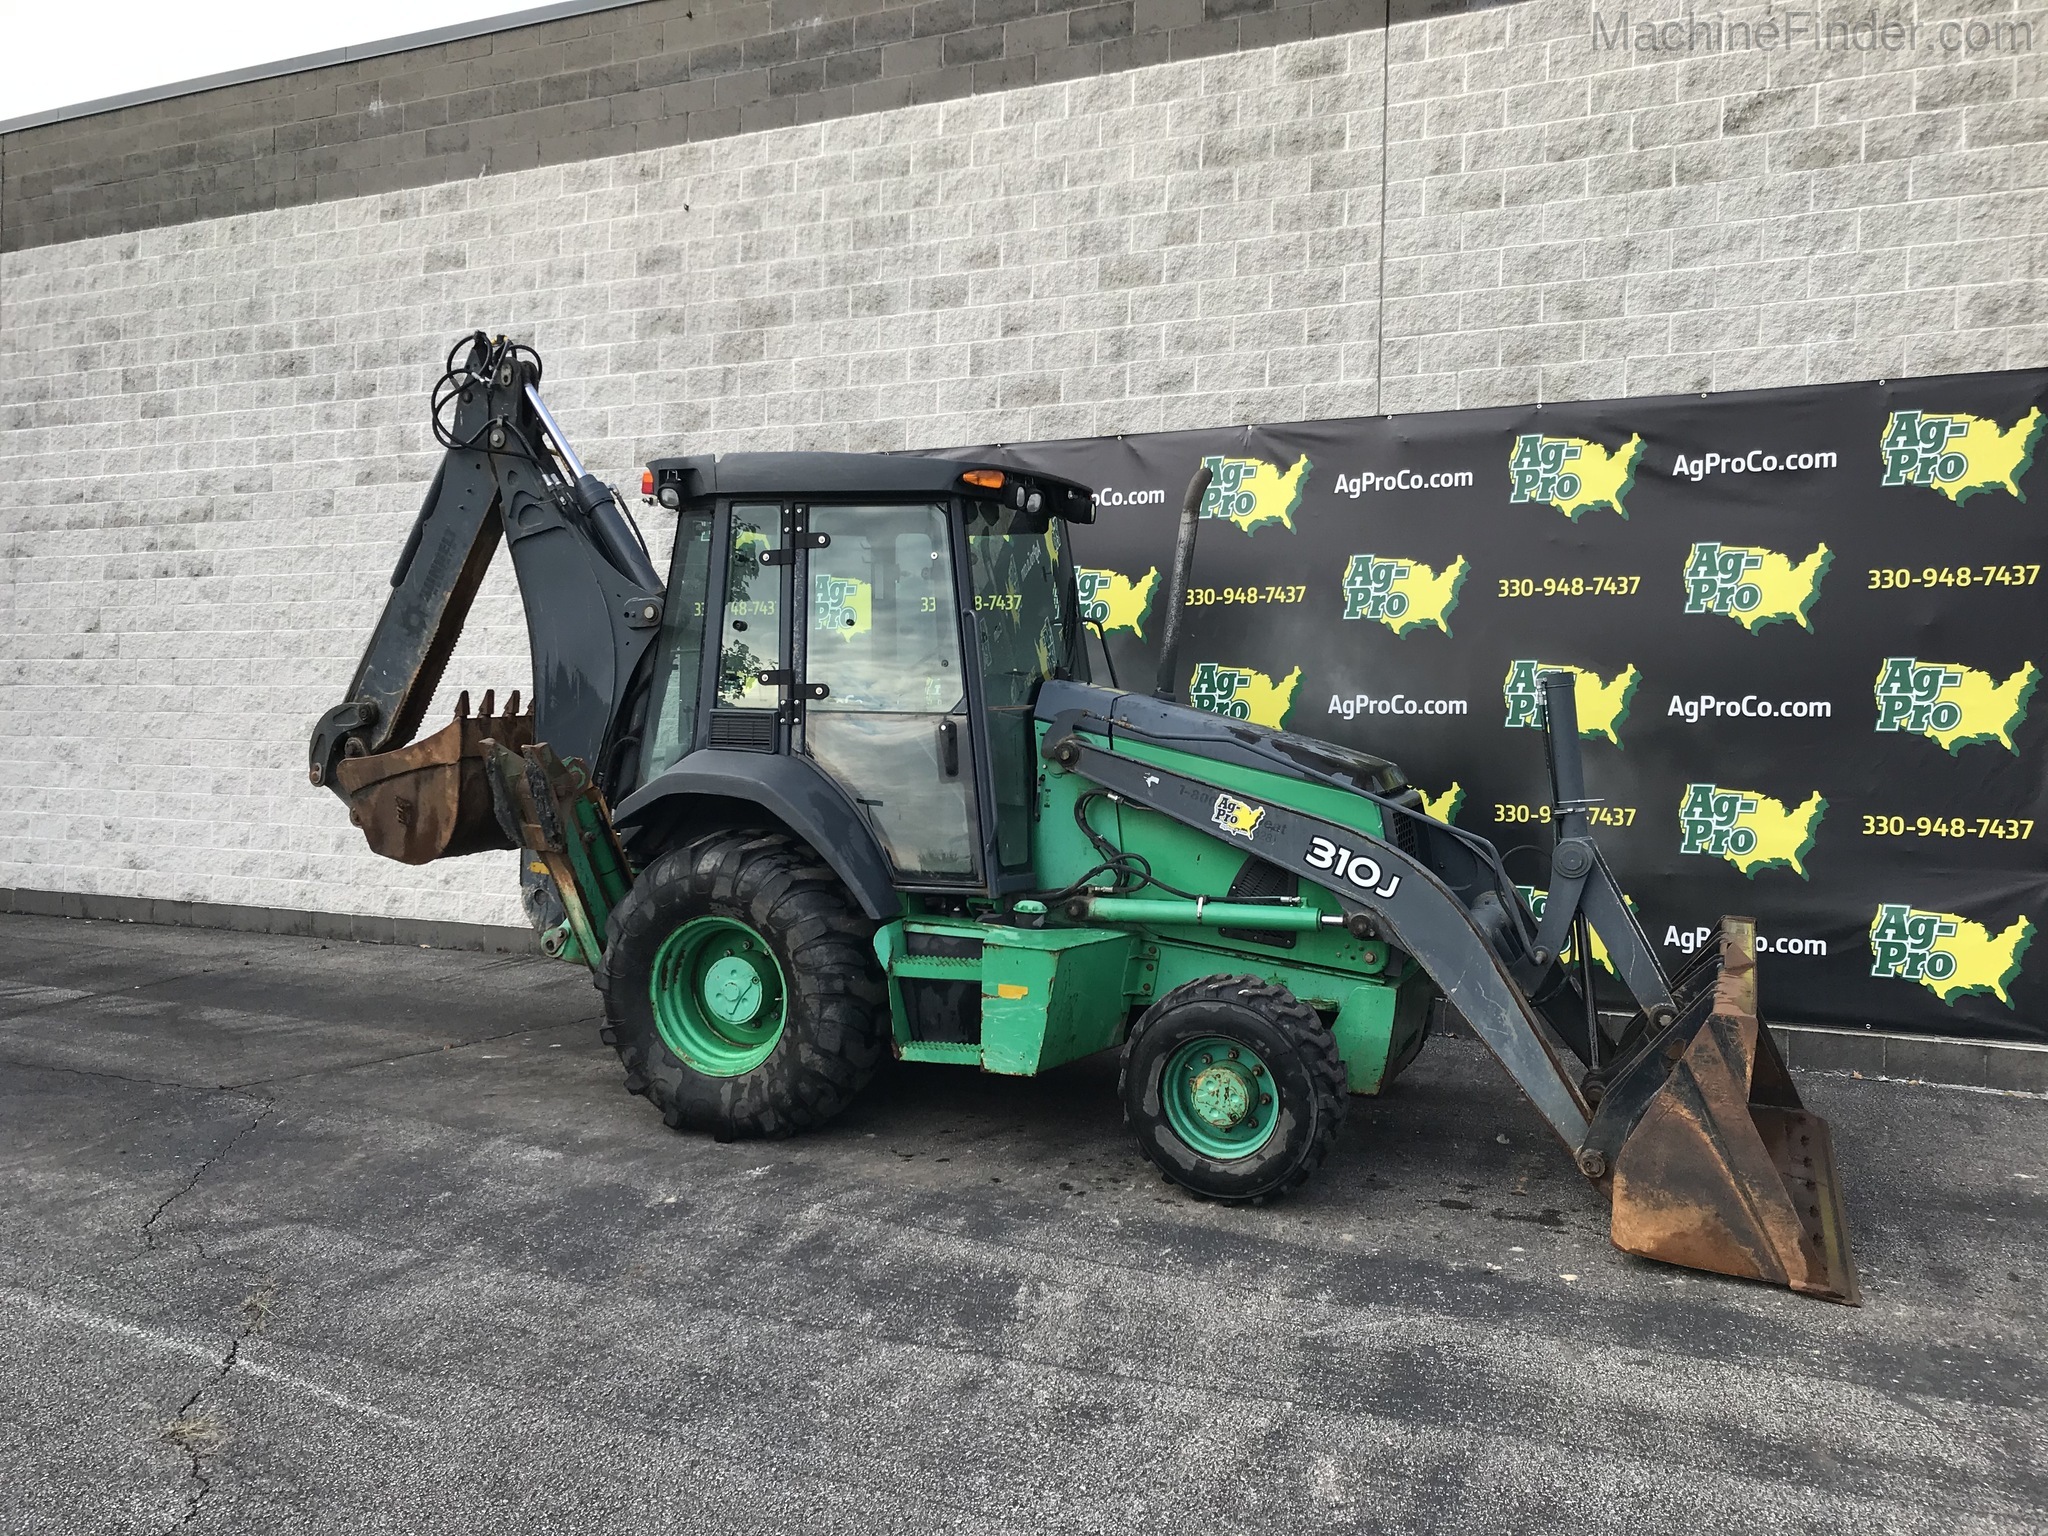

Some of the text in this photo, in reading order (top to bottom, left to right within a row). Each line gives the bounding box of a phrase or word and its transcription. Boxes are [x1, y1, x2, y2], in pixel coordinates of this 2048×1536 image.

[1883, 411, 1968, 455] Ag-
[1510, 433, 1581, 475] Ag-
[1673, 449, 1838, 482] AgProCo.com
[1882, 447, 1968, 486] Pro
[1334, 469, 1474, 499] AgProCo.com
[1510, 467, 1581, 503] Pro
[1199, 486, 1257, 519] Pro
[1343, 554, 1410, 595] Ag-
[1685, 542, 1763, 586] Ag-
[1868, 564, 2041, 590] 330-948-7437
[1074, 565, 1111, 603] g-
[1186, 585, 1306, 606] 330-948-7437
[1497, 575, 1641, 598] 330-948-7437
[1684, 577, 1763, 613] Pro
[815, 602, 858, 630] Pro
[1080, 600, 1111, 624] ro
[1343, 587, 1410, 620] Pro
[1190, 663, 1251, 702] Ag-
[1877, 657, 1963, 703] Ag-
[1193, 694, 1251, 721] Pro
[1328, 694, 1468, 720] AgProCo.com
[1668, 695, 1832, 723] AgProCo.com
[1876, 694, 1963, 732] Pro
[1214, 808, 1238, 824] Pro
[1218, 797, 1241, 813] Ag-
[1494, 804, 1637, 827] 330-97437
[1681, 784, 1758, 829] Ag-
[1680, 818, 1757, 854] Pro
[1862, 815, 2035, 840] 330-948-7437
[1303, 835, 1401, 899] 310J
[1664, 925, 1827, 956] AgPo.com
[1872, 904, 1957, 951] Ag-
[1871, 939, 1957, 979] Pro
